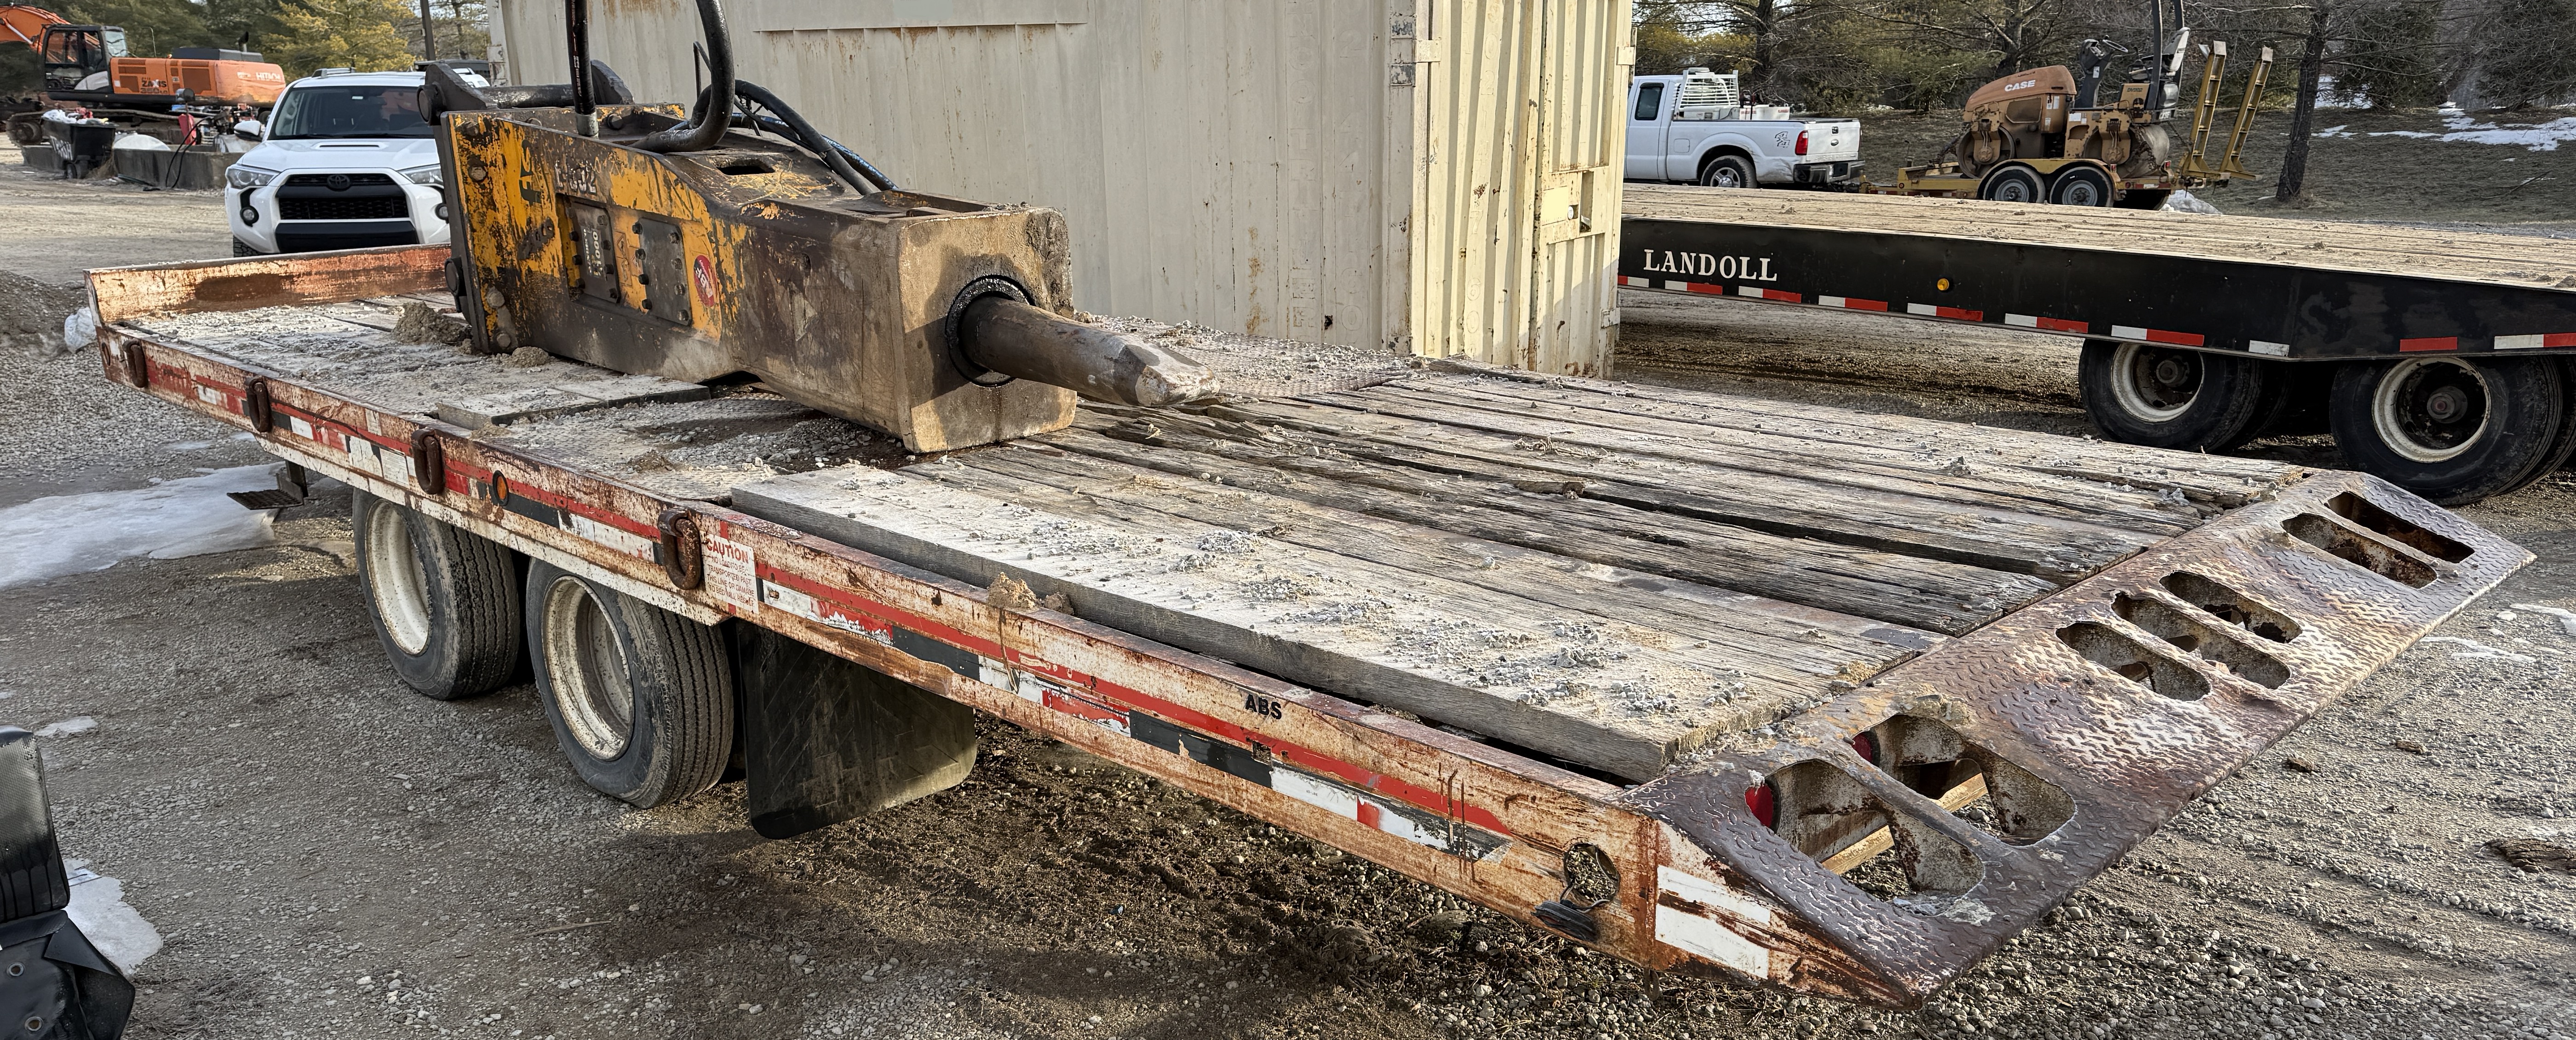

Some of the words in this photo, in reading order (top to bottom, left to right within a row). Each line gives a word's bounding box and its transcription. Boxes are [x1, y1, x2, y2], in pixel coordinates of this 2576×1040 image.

[142, 79, 166, 87] ZAXIS
[2005, 80, 2036, 92] CASE
[1643, 249, 1777, 281] LANDOLL
[706, 538, 749, 564] CAUTION
[707, 564, 740, 581] TRANSPORTED
[740, 576, 752, 585] PAST
[720, 559, 730, 568] LOAD
[707, 574, 717, 583] THIS
[717, 577, 728, 587] LINE
[736, 585, 754, 597] DAMAGE
[708, 584, 715, 592] TO
[716, 587, 725, 596] BED
[726, 590, 736, 600] WILL
[737, 595, 754, 606] RESULT
[1245, 694, 1282, 719] ABS
